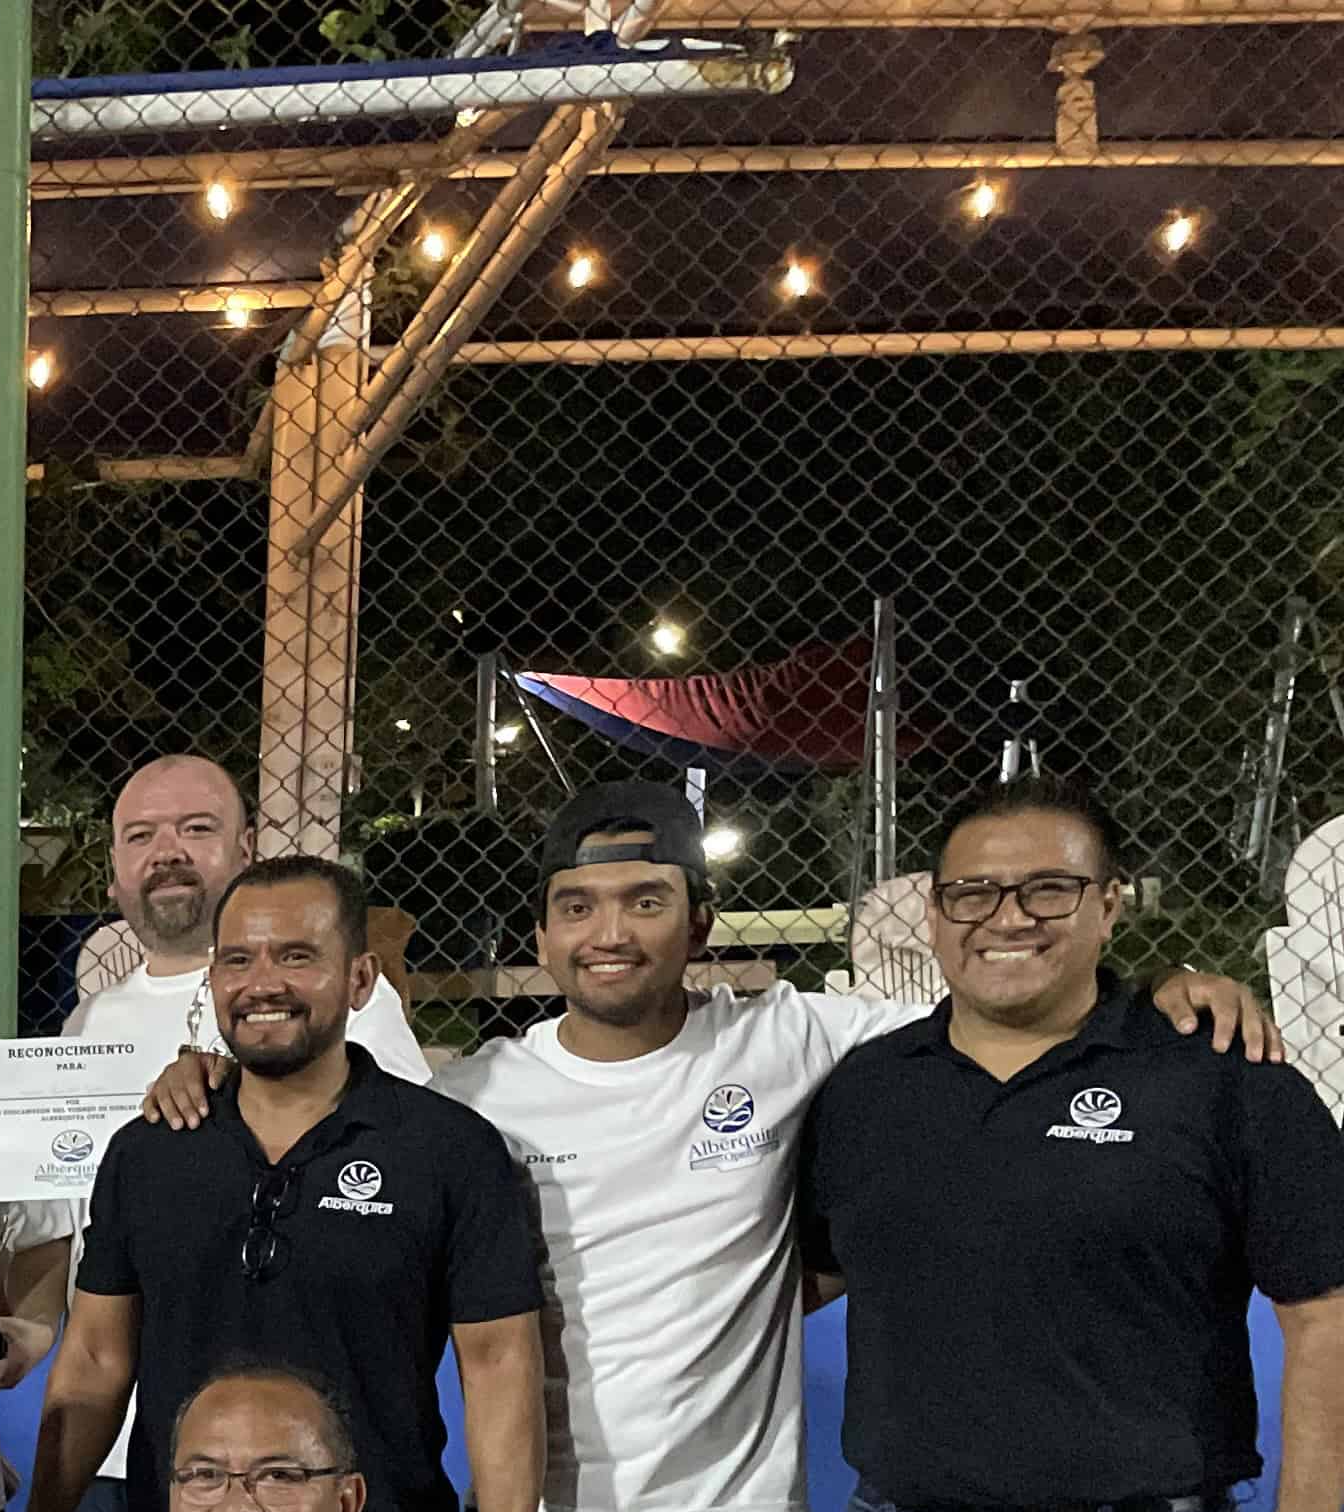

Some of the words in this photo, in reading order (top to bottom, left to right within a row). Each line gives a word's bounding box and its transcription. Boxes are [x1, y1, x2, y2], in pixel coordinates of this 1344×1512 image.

[8, 1044, 135, 1059] RECONOCIMIENTO
[56, 1062, 87, 1071] PARA:
[525, 1152, 577, 1164] Diego
